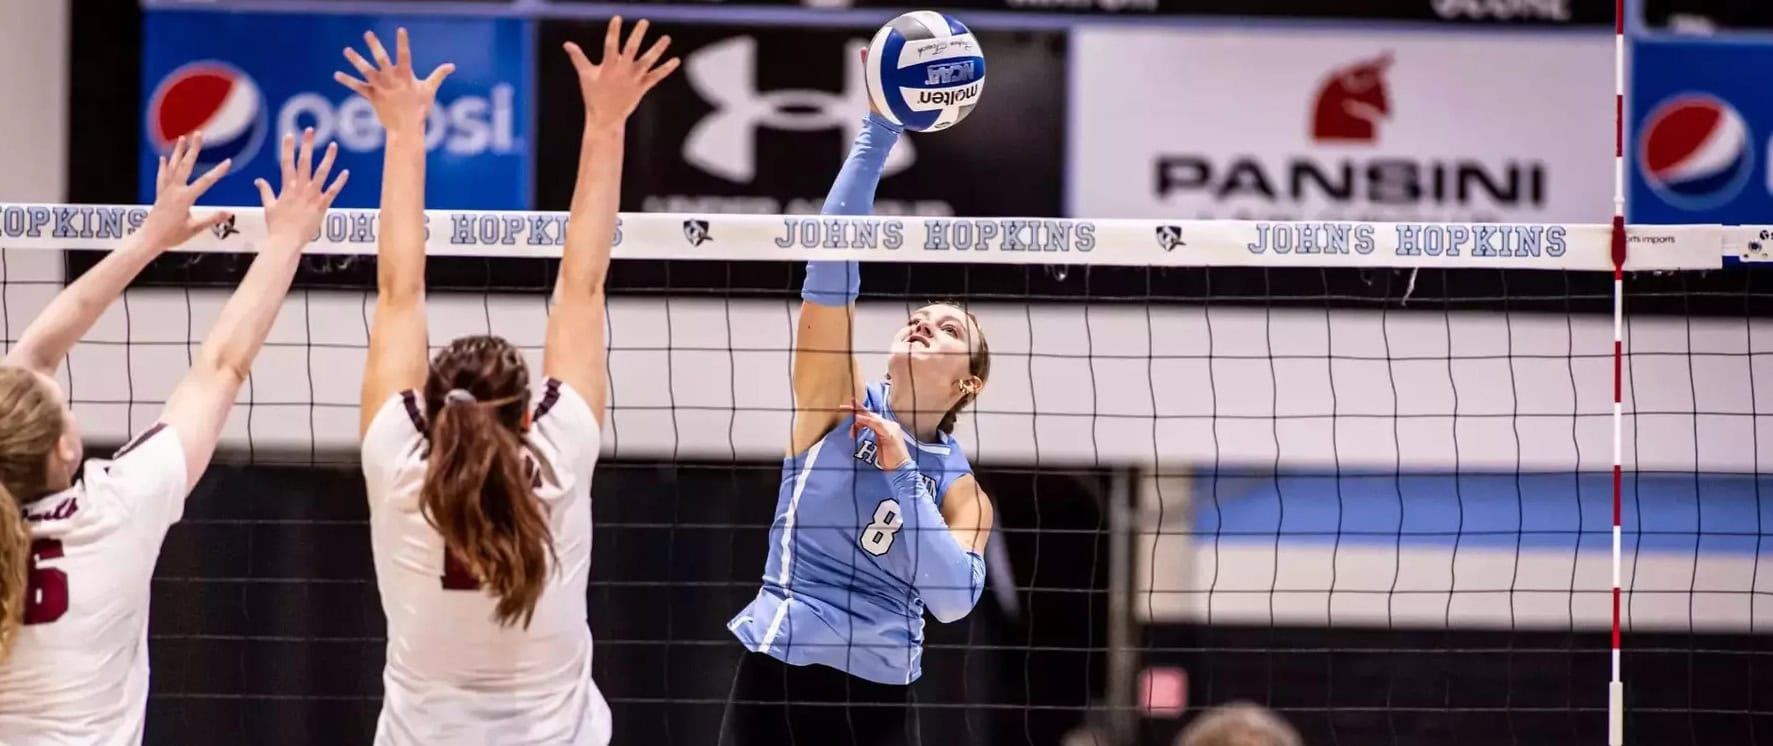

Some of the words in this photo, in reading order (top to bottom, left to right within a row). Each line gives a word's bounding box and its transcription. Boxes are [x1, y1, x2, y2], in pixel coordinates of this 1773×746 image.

[926, 60, 975, 85] NCAA
[920, 84, 978, 106] molten
[1154, 155, 1547, 206] PANSINI
[0, 206, 148, 239] OPKINS
[450, 214, 623, 246] HOPKI
[775, 218, 904, 249] JOHNS
[923, 220, 1097, 252] HOPKINS
[1247, 223, 1376, 254] JOHNS
[1395, 225, 1567, 257] HOPKINS
[1642, 236, 1675, 244] imports
[859, 498, 904, 557] 8
